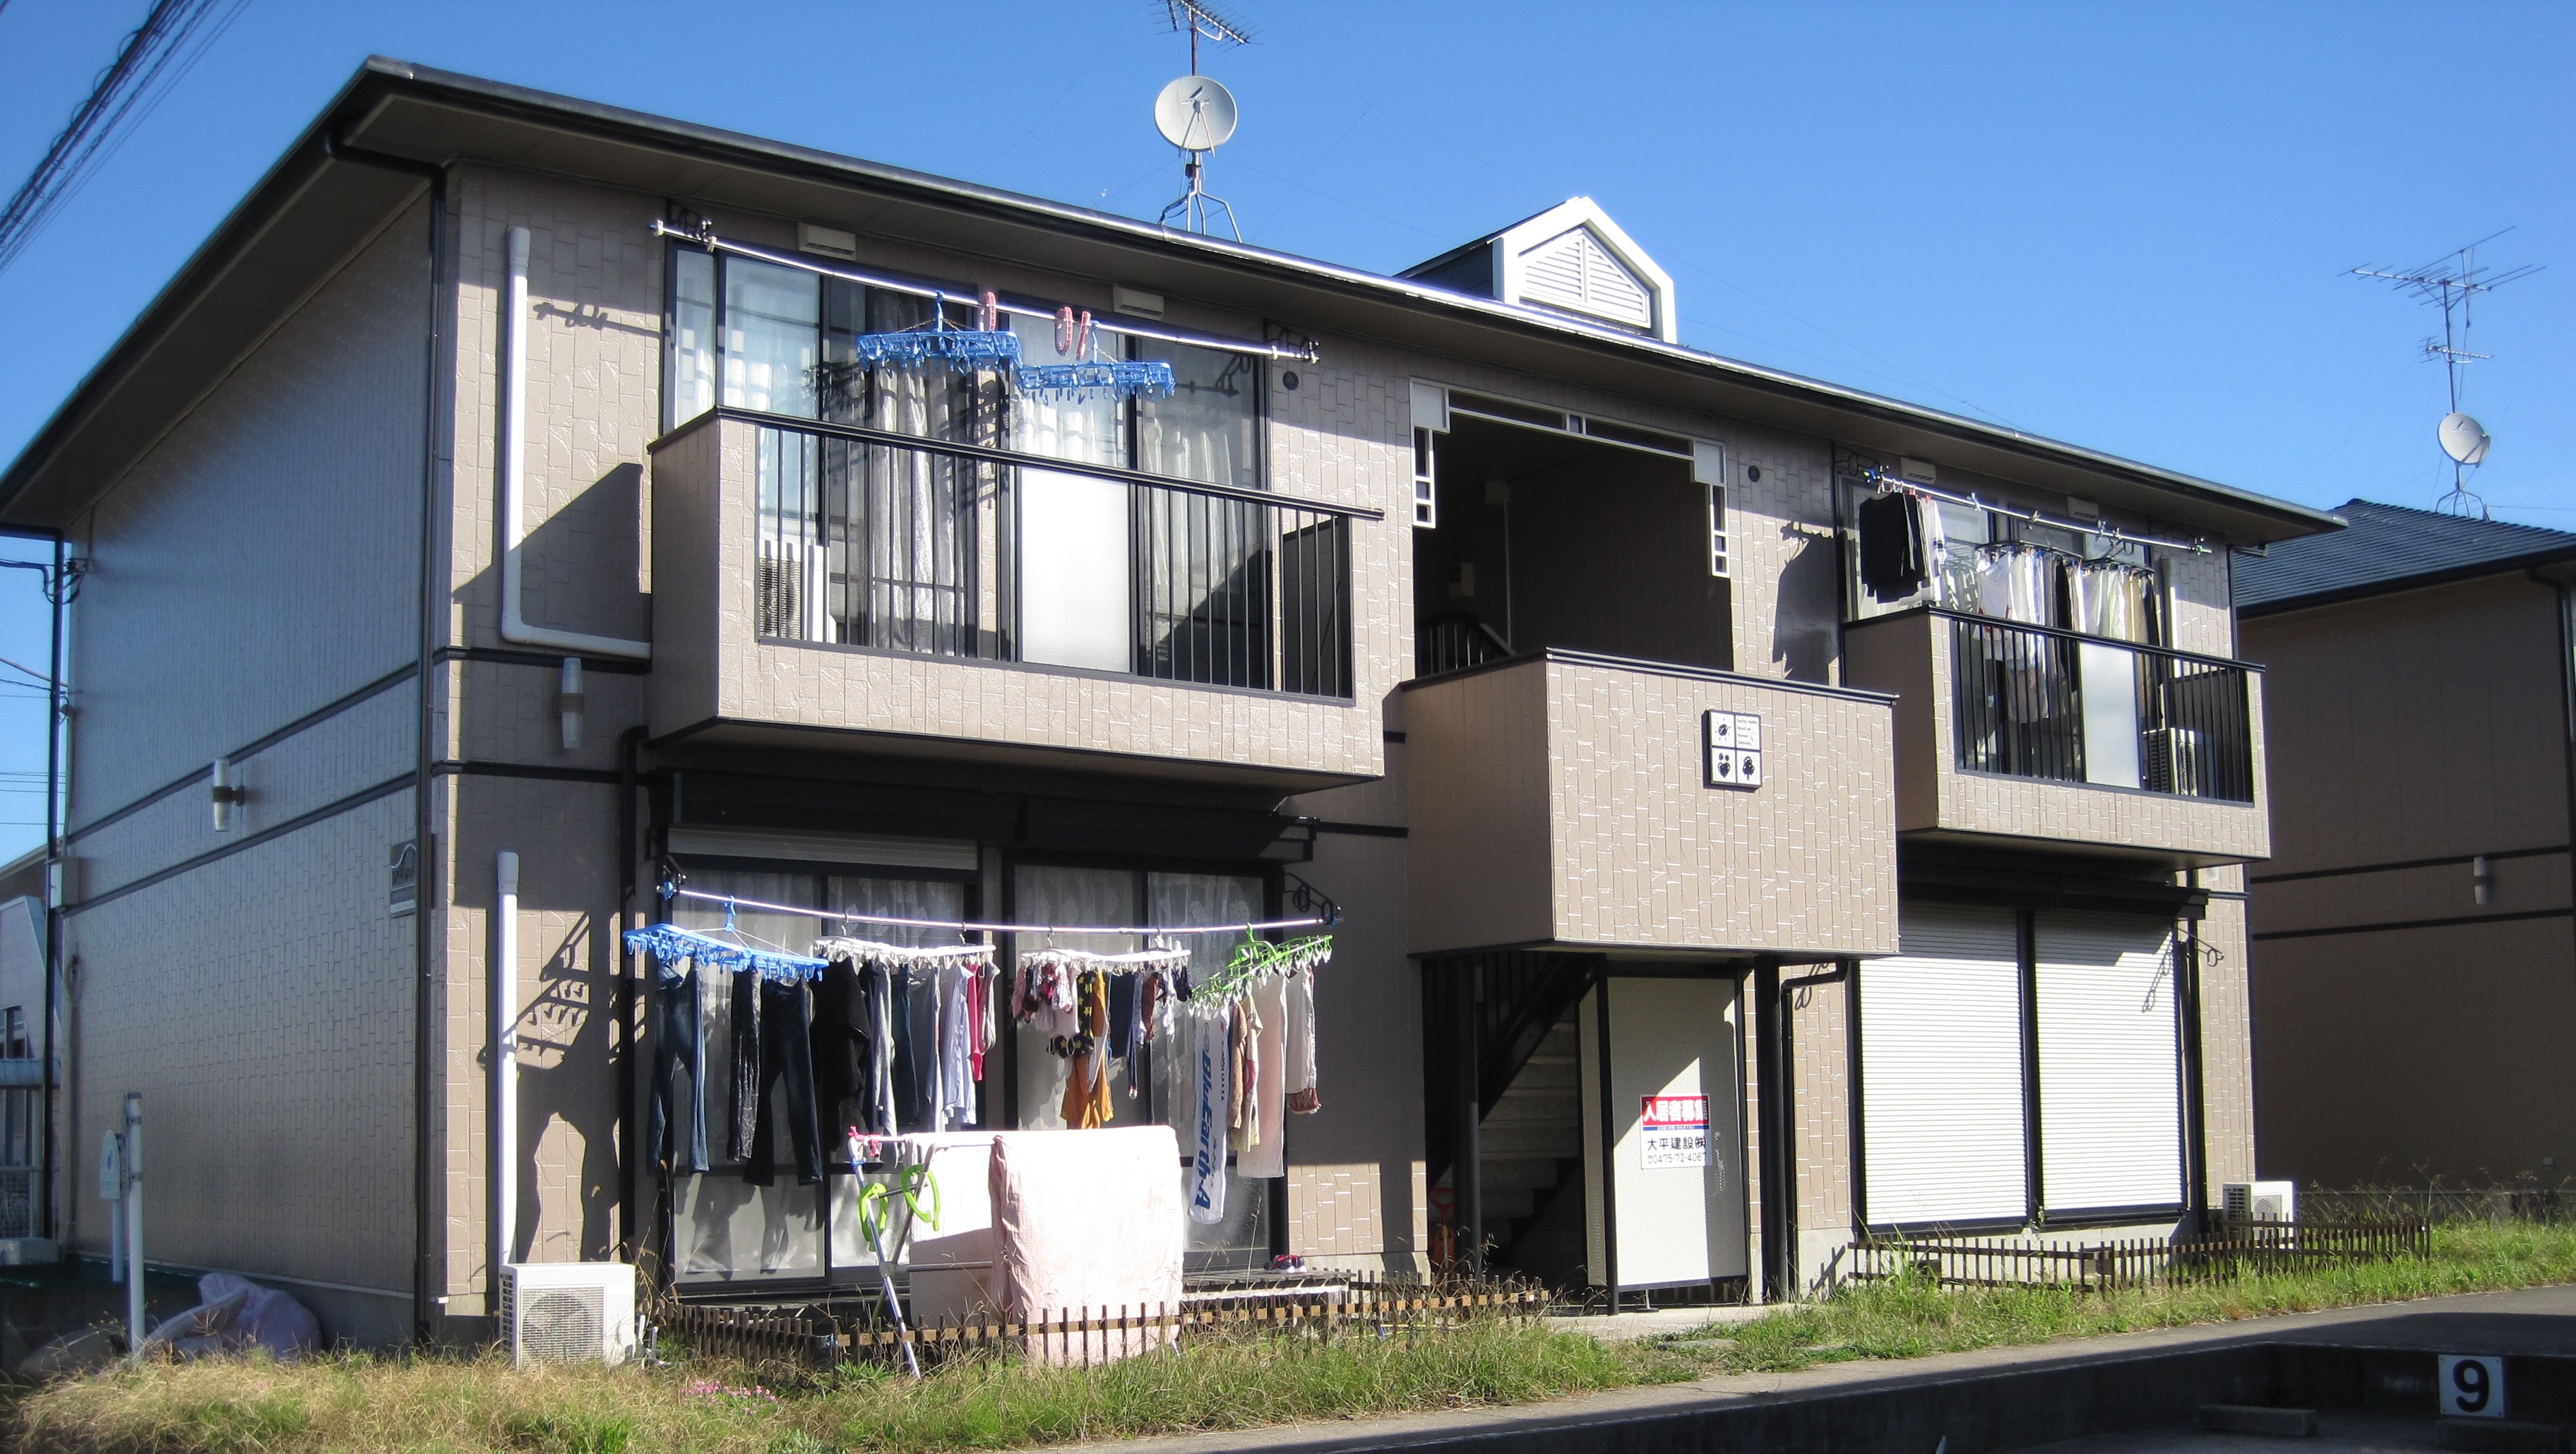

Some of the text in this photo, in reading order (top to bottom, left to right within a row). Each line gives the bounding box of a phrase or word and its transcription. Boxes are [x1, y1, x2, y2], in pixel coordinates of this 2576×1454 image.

[1643, 1099, 1708, 1122] 入居者募集
[2452, 1359, 2489, 1413] 9
